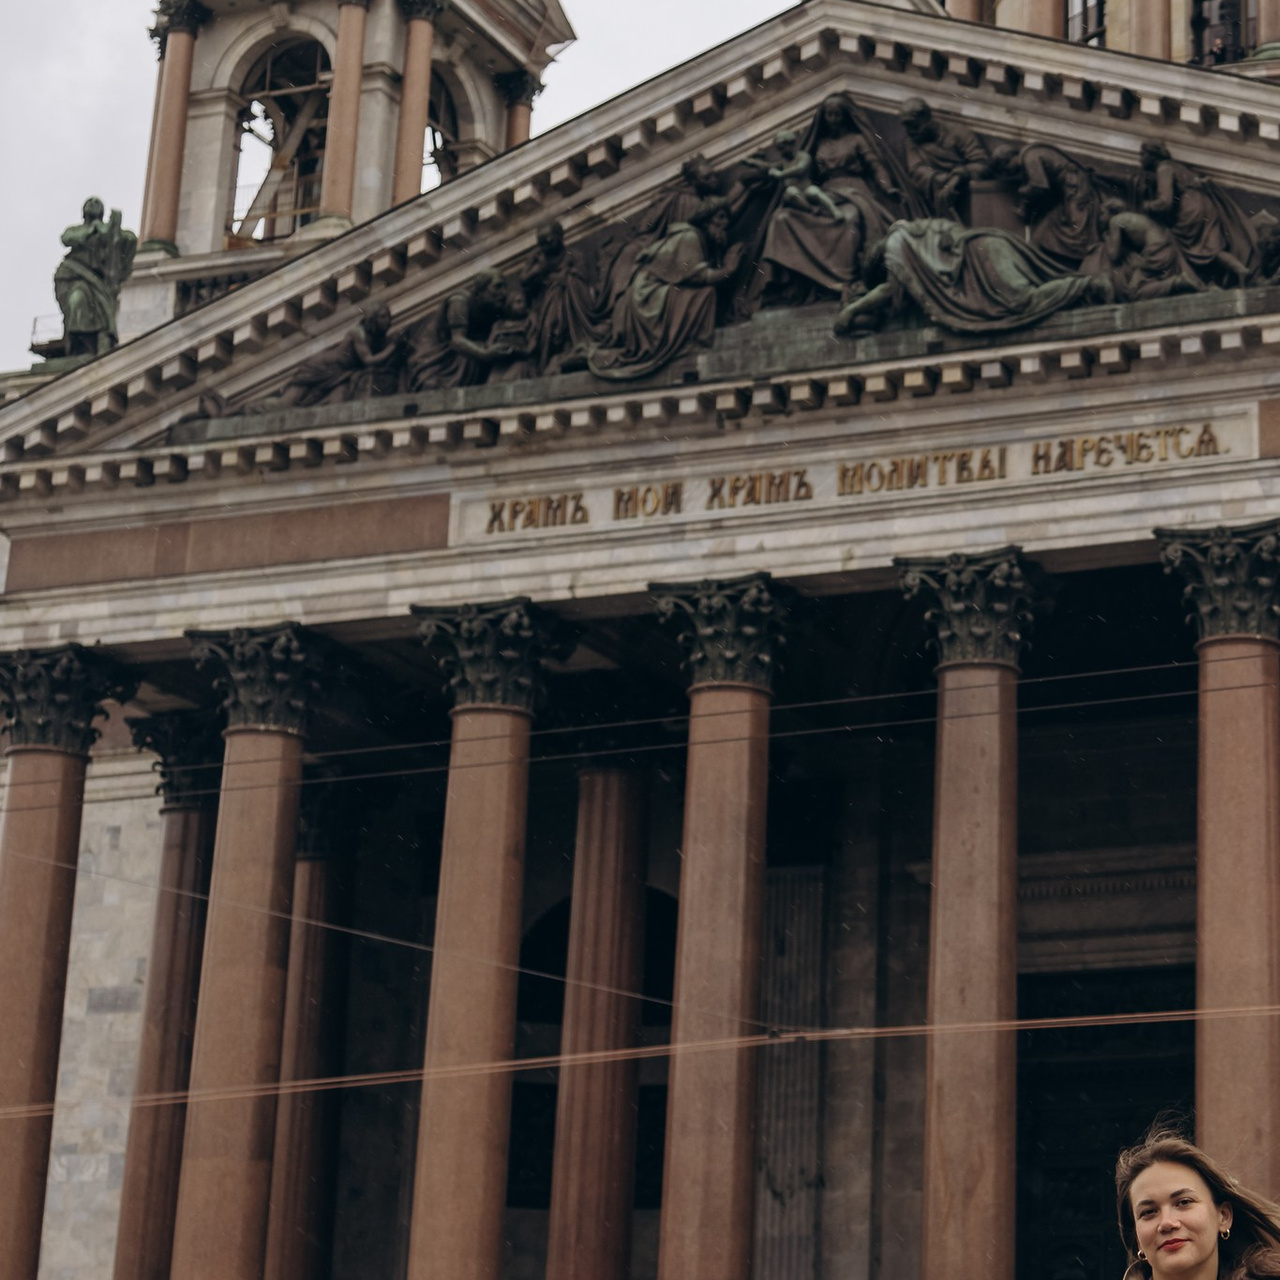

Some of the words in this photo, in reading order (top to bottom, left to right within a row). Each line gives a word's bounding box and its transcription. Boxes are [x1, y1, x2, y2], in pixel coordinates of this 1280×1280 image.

[486, 493, 589, 534] ХРАМЪ
[705, 469, 813, 511] ХРАМЪ
[837, 446, 1007, 496] МОЛИТВЫ
